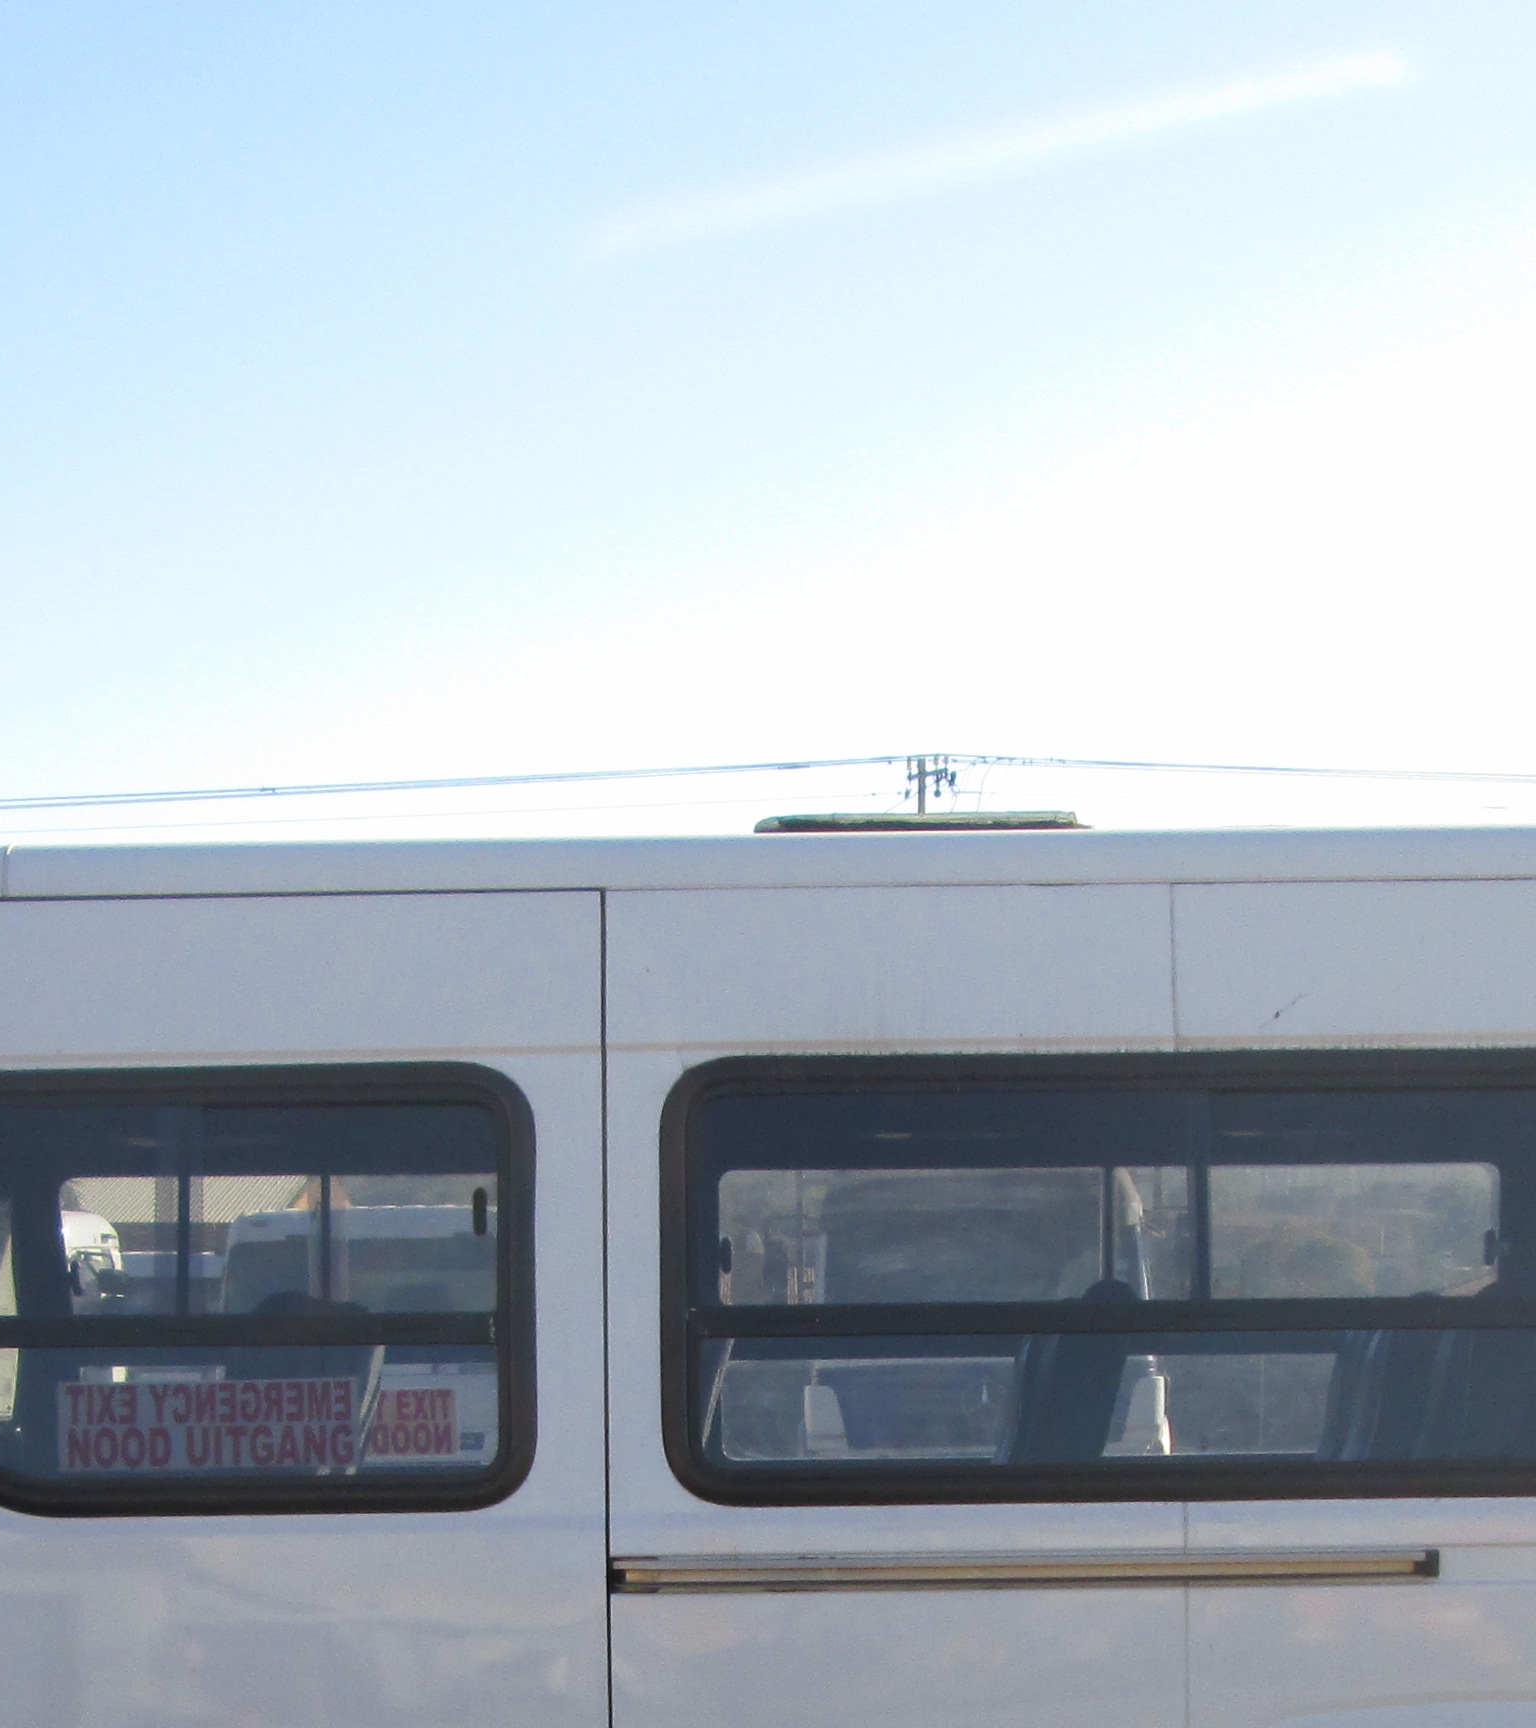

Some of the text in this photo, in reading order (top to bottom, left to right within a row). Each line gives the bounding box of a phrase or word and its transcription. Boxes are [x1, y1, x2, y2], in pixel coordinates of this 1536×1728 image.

[396, 1388, 453, 1421] EXIT
[67, 1424, 354, 1468] NOOD UITGANG
